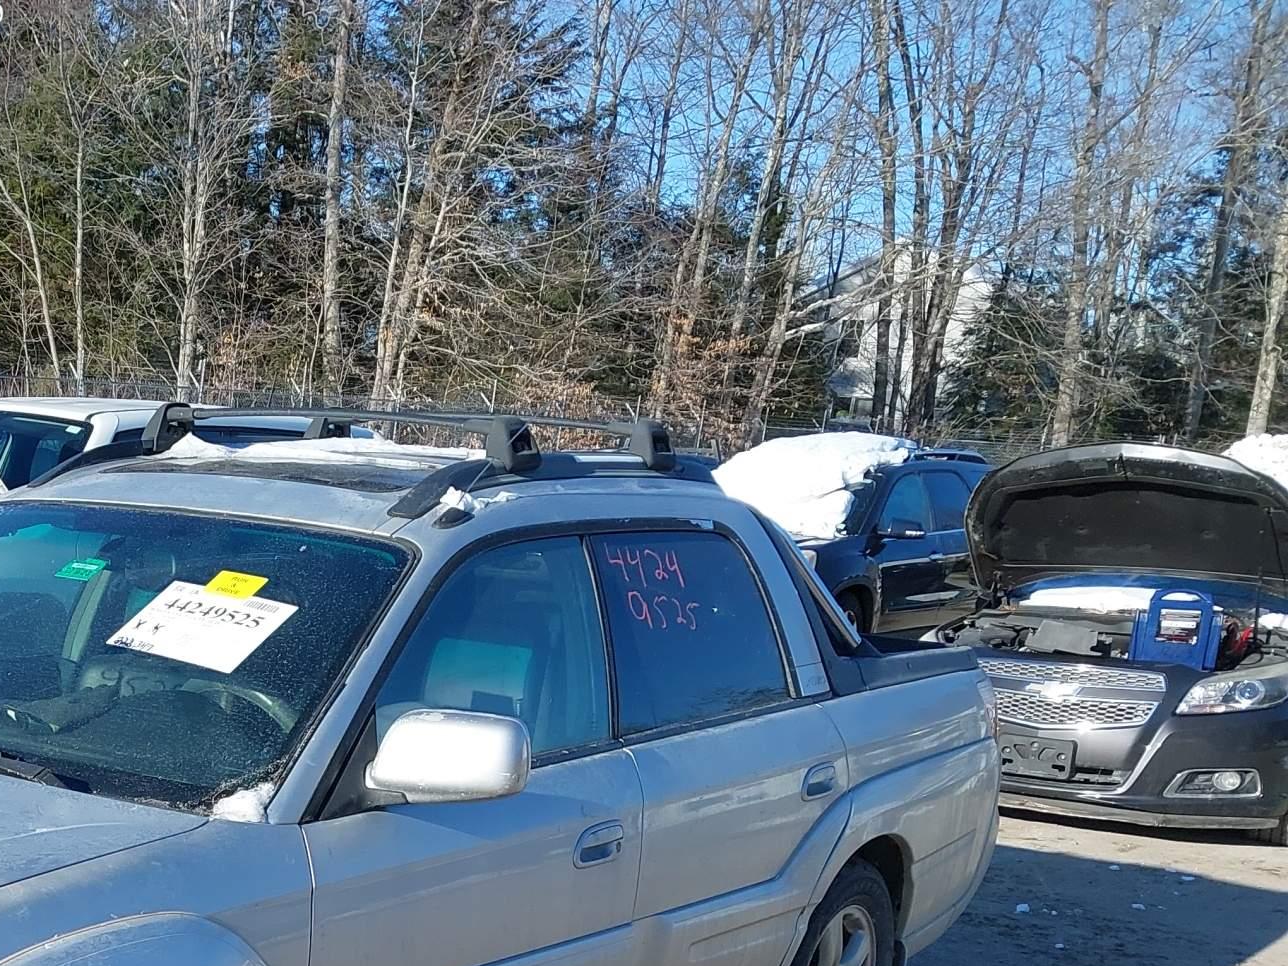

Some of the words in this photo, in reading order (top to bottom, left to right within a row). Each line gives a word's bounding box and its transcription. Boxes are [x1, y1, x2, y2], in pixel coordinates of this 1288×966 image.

[603, 541, 685, 588] 4424
[164, 598, 267, 629] 44249525
[626, 589, 700, 631] 9525
